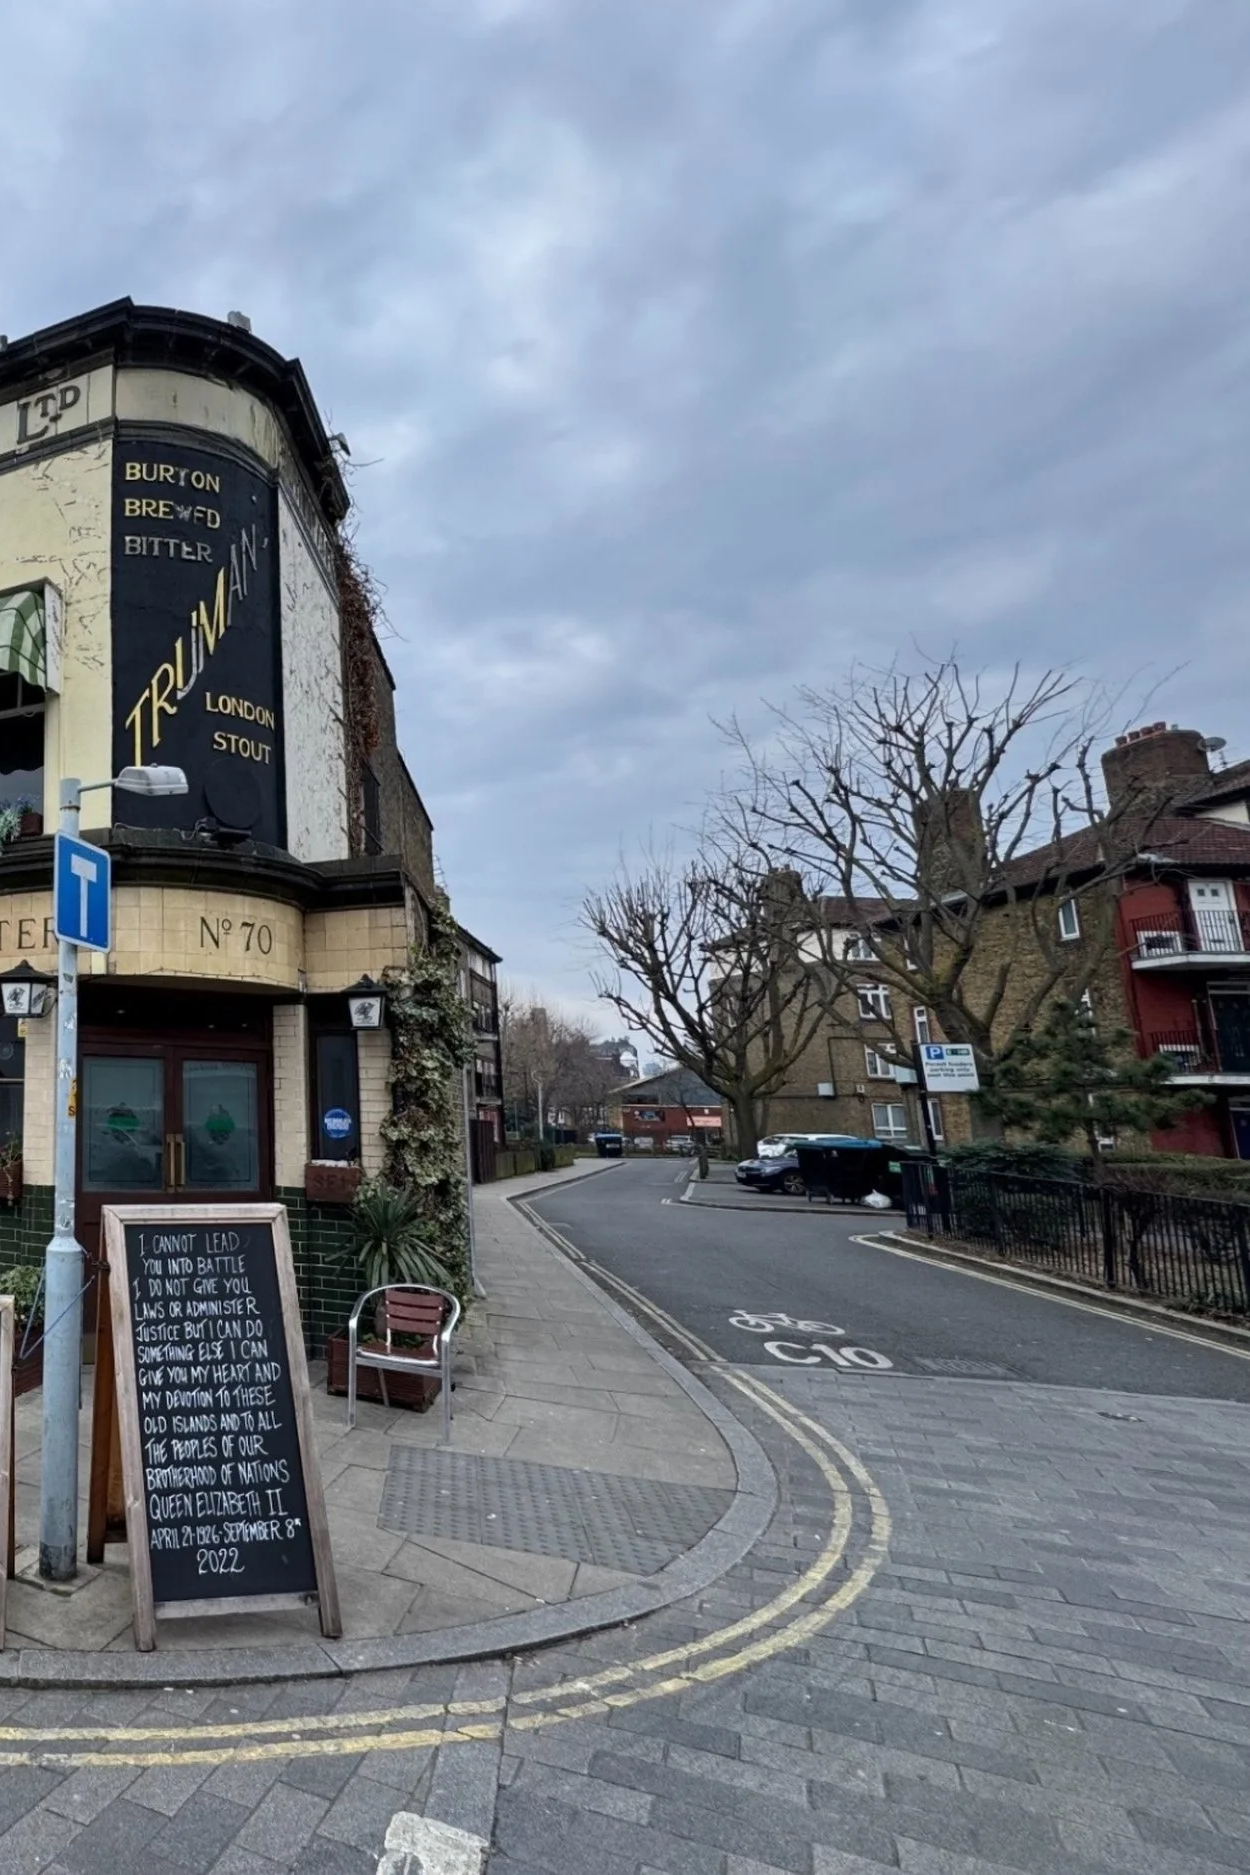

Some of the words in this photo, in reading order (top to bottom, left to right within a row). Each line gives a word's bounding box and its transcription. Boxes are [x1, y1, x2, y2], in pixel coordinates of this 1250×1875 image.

[125, 462, 220, 493] BURTON
[124, 498, 221, 529] BREWED
[124, 535, 213, 562] BITTER
[205, 691, 275, 730] LONDON
[213, 731, 272, 766] STOUT
[240, 921, 272, 955] 70
[138, 1233, 145, 1257] I
[152, 1233, 197, 1254] CANNOT
[205, 1231, 240, 1253] LEAD
[142, 1258, 162, 1275] YOU
[168, 1257, 193, 1275] INTO
[197, 1254, 246, 1275] BATTLE
[148, 1278, 162, 1297] DO
[165, 1278, 190, 1296] NOT
[193, 1278, 218, 1295] GIVE
[223, 1276, 252, 1294] YOU
[134, 1301, 165, 1320] LAWS
[169, 1301, 183, 1318] OR
[186, 1297, 261, 1317] ADMINISTER
[135, 1321, 180, 1342] JUSTICE
[183, 1319, 208, 1339] BUT
[209, 1320, 214, 1339] I
[217, 1319, 241, 1339] CAN
[246, 1319, 263, 1338] DO
[137, 1342, 195, 1364] SOMETHING
[198, 1340, 224, 1361] ELSE
[230, 1340, 236, 1360] I
[240, 1340, 268, 1359] CAN
[764, 1341, 894, 1369] C10
[138, 1365, 165, 1386] GIVE
[166, 1366, 188, 1384] YOU
[191, 1365, 210, 1384] MY
[212, 1361, 251, 1384] HEART
[255, 1361, 281, 1383] AND
[142, 1391, 161, 1410] MY
[166, 1387, 213, 1410] DEVOTION
[215, 1385, 231, 1408] TO
[232, 1384, 276, 1408] THESE
[144, 1416, 167, 1434] OLD
[172, 1413, 217, 1433] ISLANDS
[220, 1413, 240, 1431] AND
[240, 1410, 255, 1432] TO
[258, 1410, 282, 1431] ALL
[145, 1438, 168, 1464] THE
[171, 1436, 218, 1460] PEOPLES
[221, 1435, 235, 1458] OF
[238, 1435, 269, 1456] OUR
[145, 1464, 217, 1490] BROTHERHOOD
[220, 1462, 235, 1485] OF
[237, 1459, 290, 1485] NATIONS
[150, 1493, 193, 1522] QUEEN
[196, 1490, 262, 1518] ELIZABETH
[265, 1488, 288, 1516] II
[150, 1526, 180, 1550] APRIL
[196, 1547, 245, 1574] 2022
